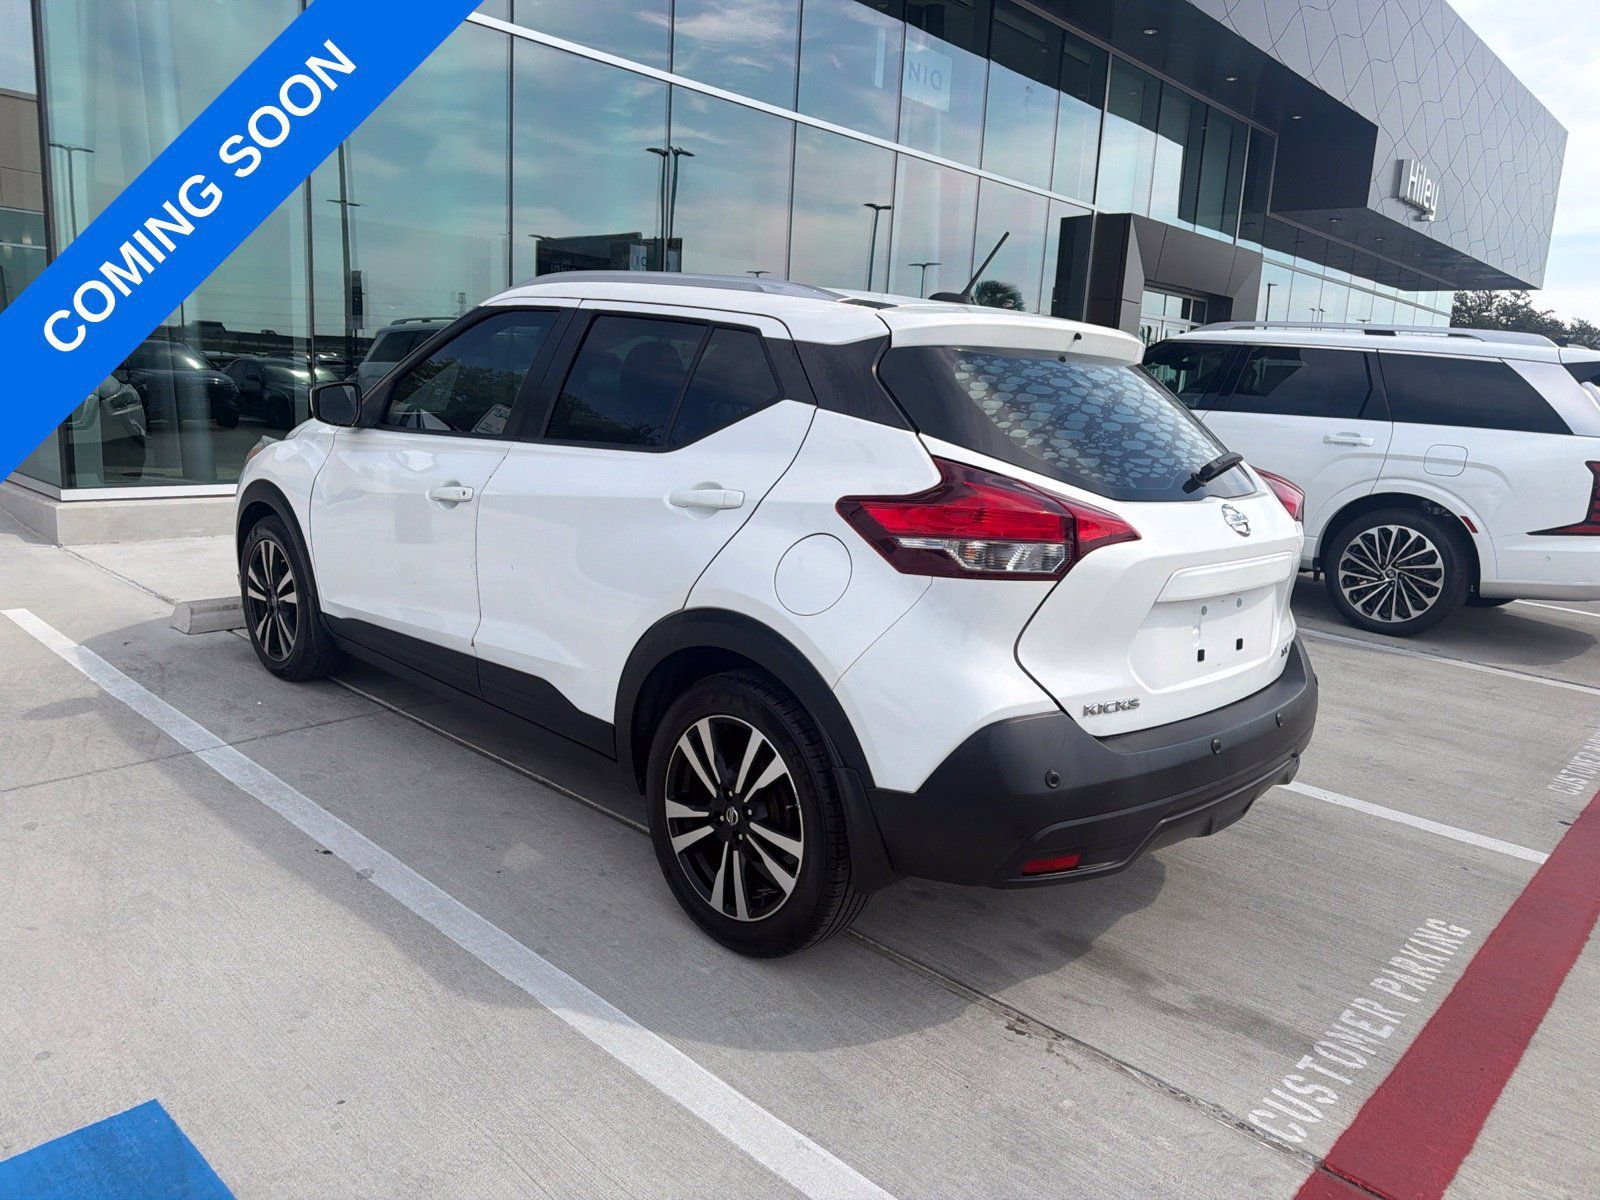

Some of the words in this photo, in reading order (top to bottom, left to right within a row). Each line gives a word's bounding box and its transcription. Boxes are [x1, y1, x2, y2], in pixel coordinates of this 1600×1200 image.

[1406, 159, 1440, 222] Hiley
[1083, 698, 1140, 717] KICKS
[1248, 997, 1406, 1143] CUSTOMER
[1369, 918, 1471, 1003] PARKING
